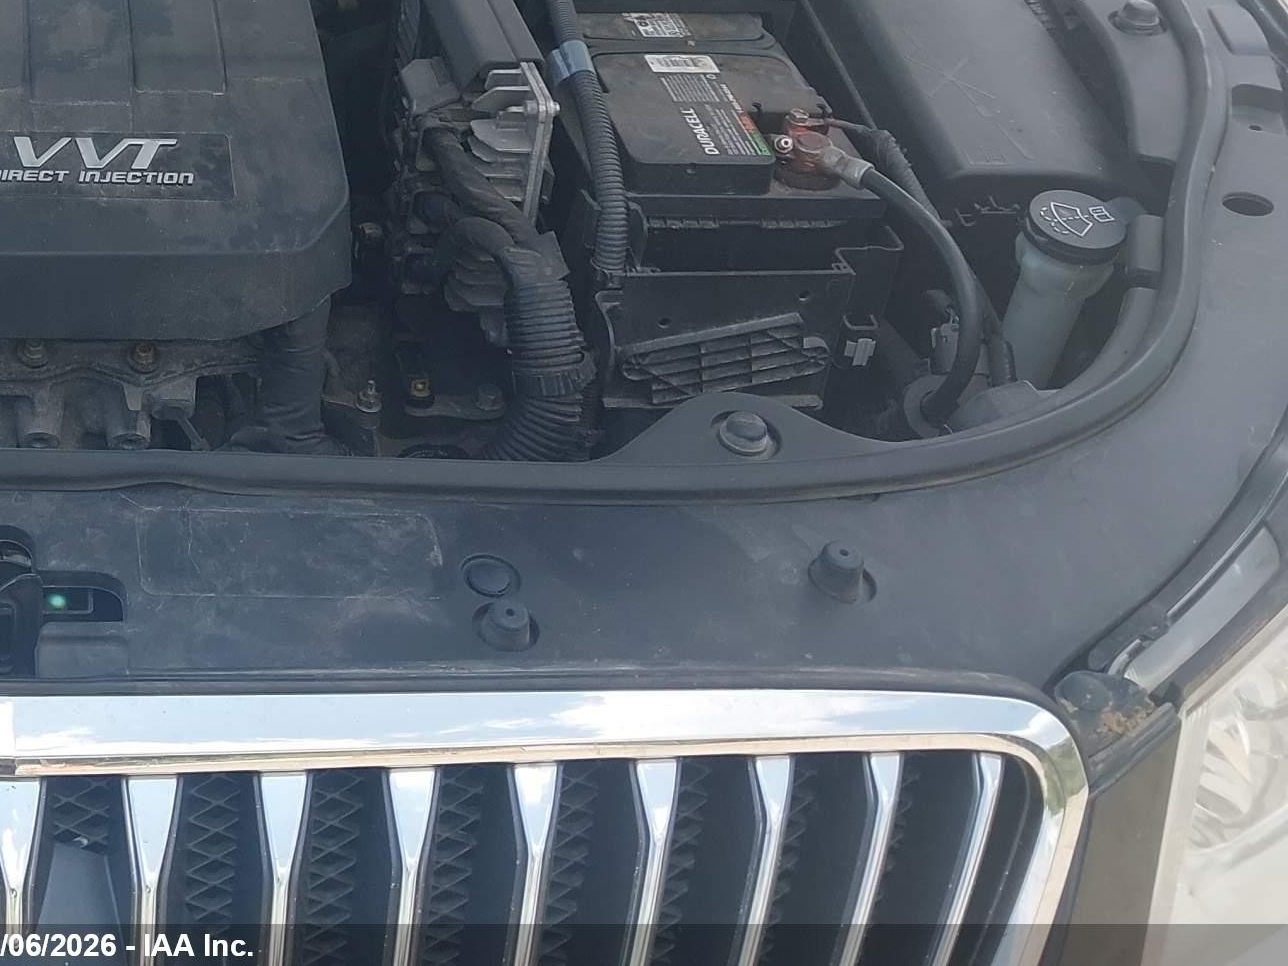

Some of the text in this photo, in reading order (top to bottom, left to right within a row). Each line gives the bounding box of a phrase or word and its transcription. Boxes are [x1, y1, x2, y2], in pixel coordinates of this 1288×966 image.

[680, 107, 721, 155] DURACELL
[13, 136, 179, 169] VVT
[78, 169, 196, 186] INJECTION
